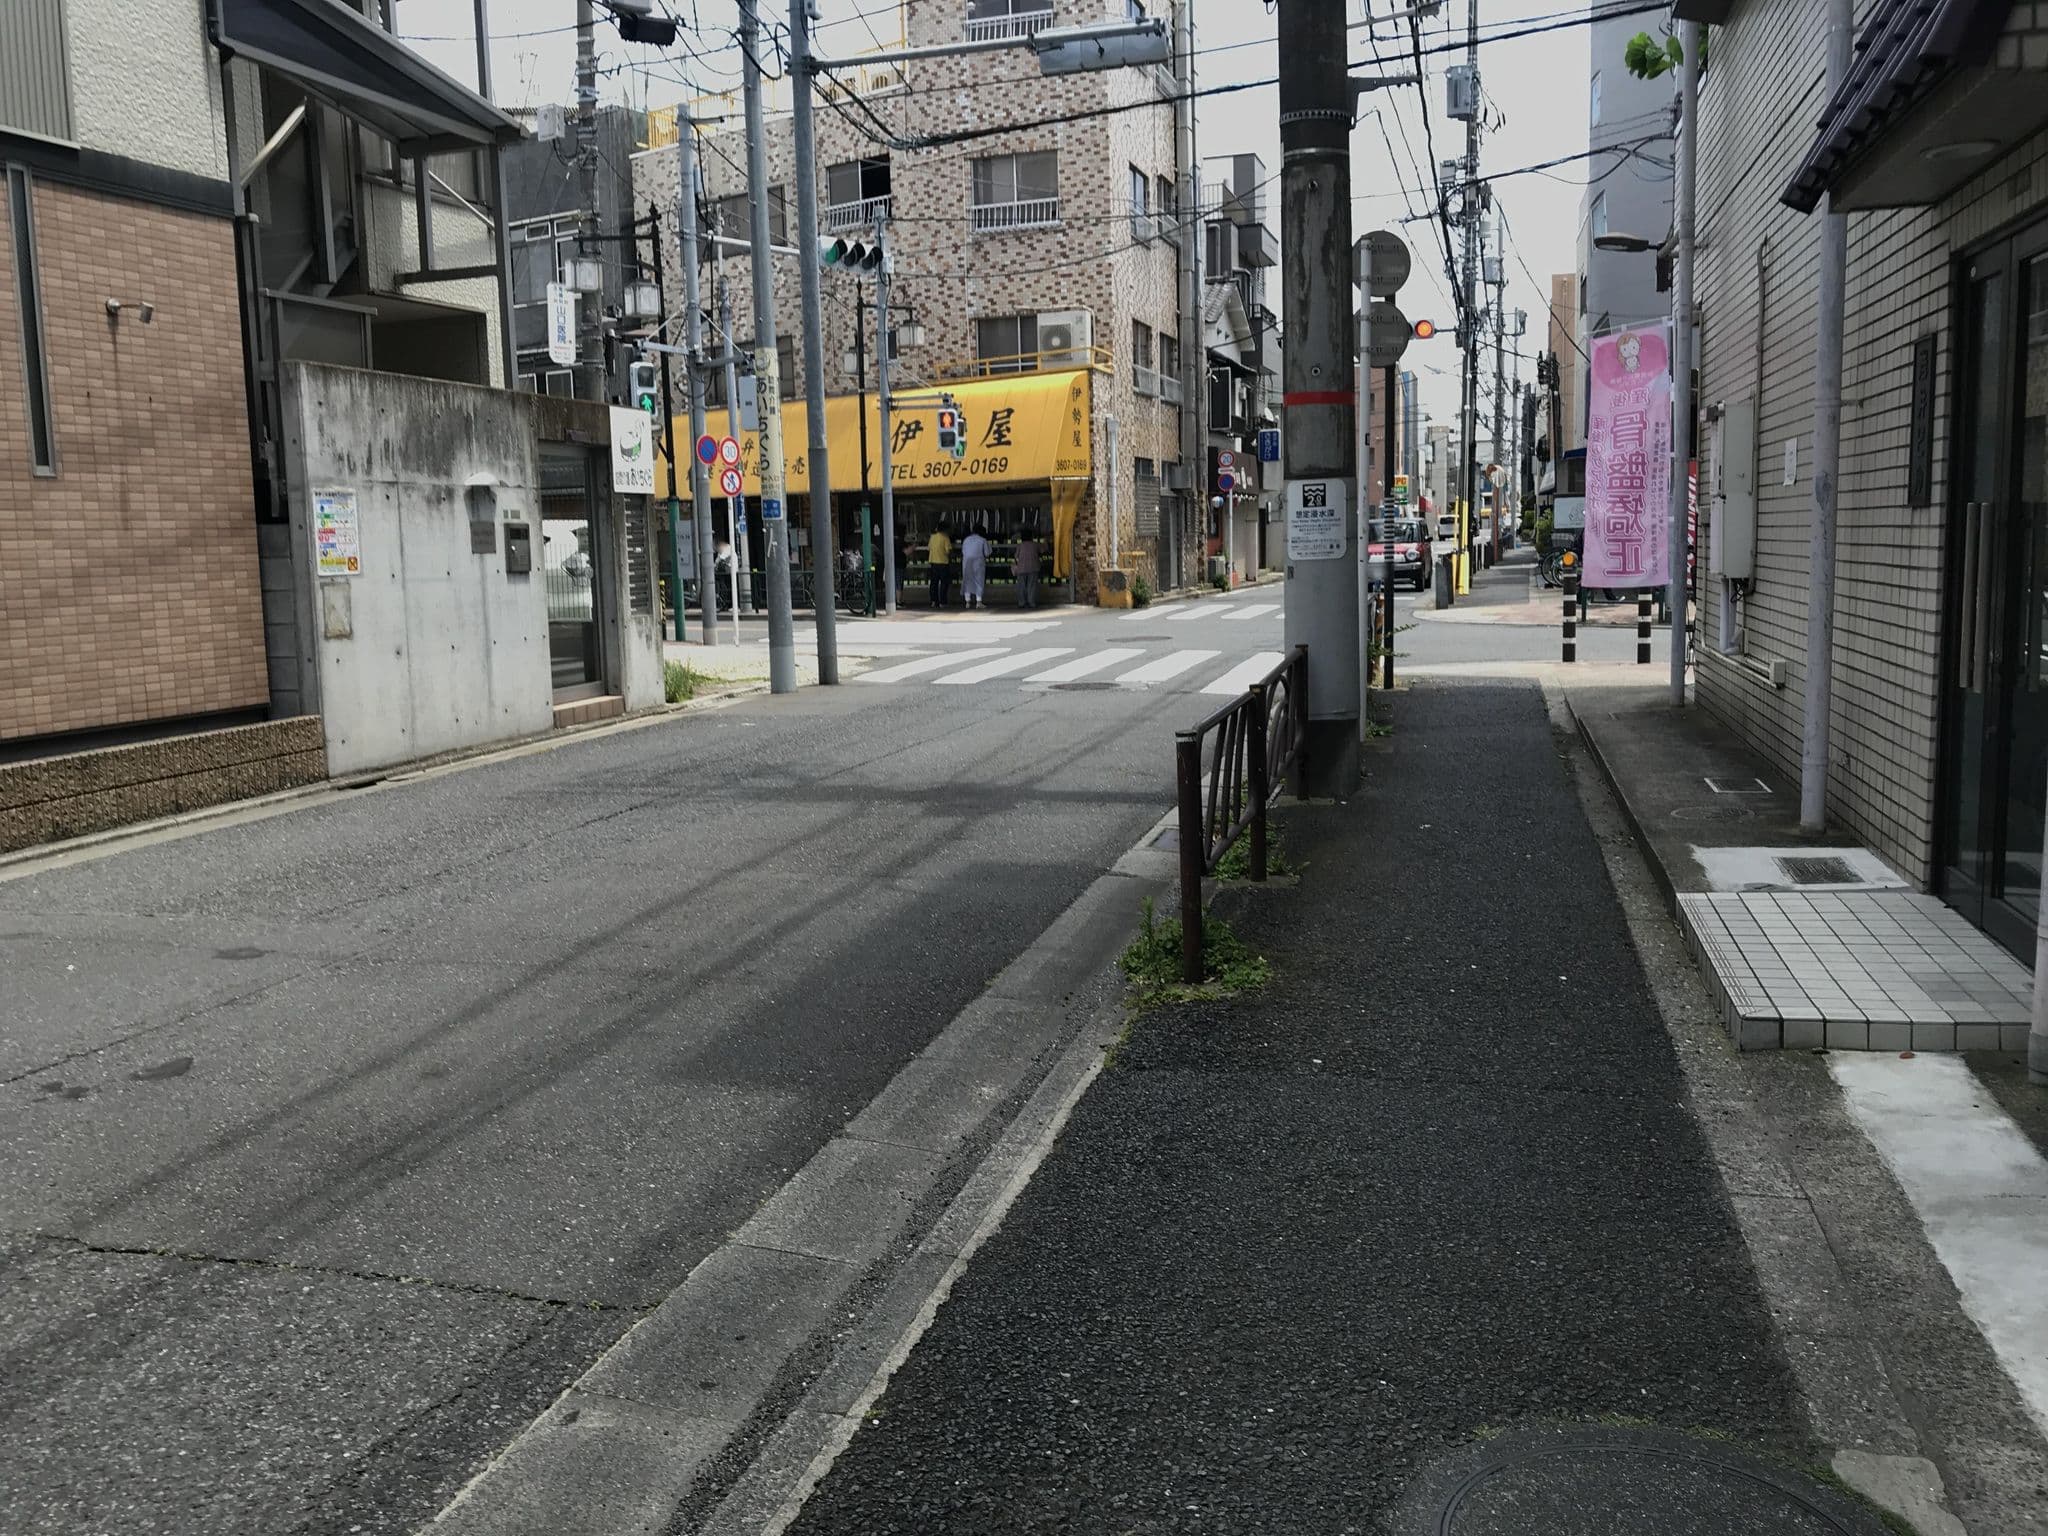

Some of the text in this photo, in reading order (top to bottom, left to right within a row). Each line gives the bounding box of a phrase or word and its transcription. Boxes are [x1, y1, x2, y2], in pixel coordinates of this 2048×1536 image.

[557, 305, 567, 344] 山口医院
[1072, 386, 1083, 448] 伊勢屋
[724, 444, 737, 459] 30
[891, 457, 1009, 480] TEL 3607-0169
[1056, 459, 1088, 471] 3607-0169
